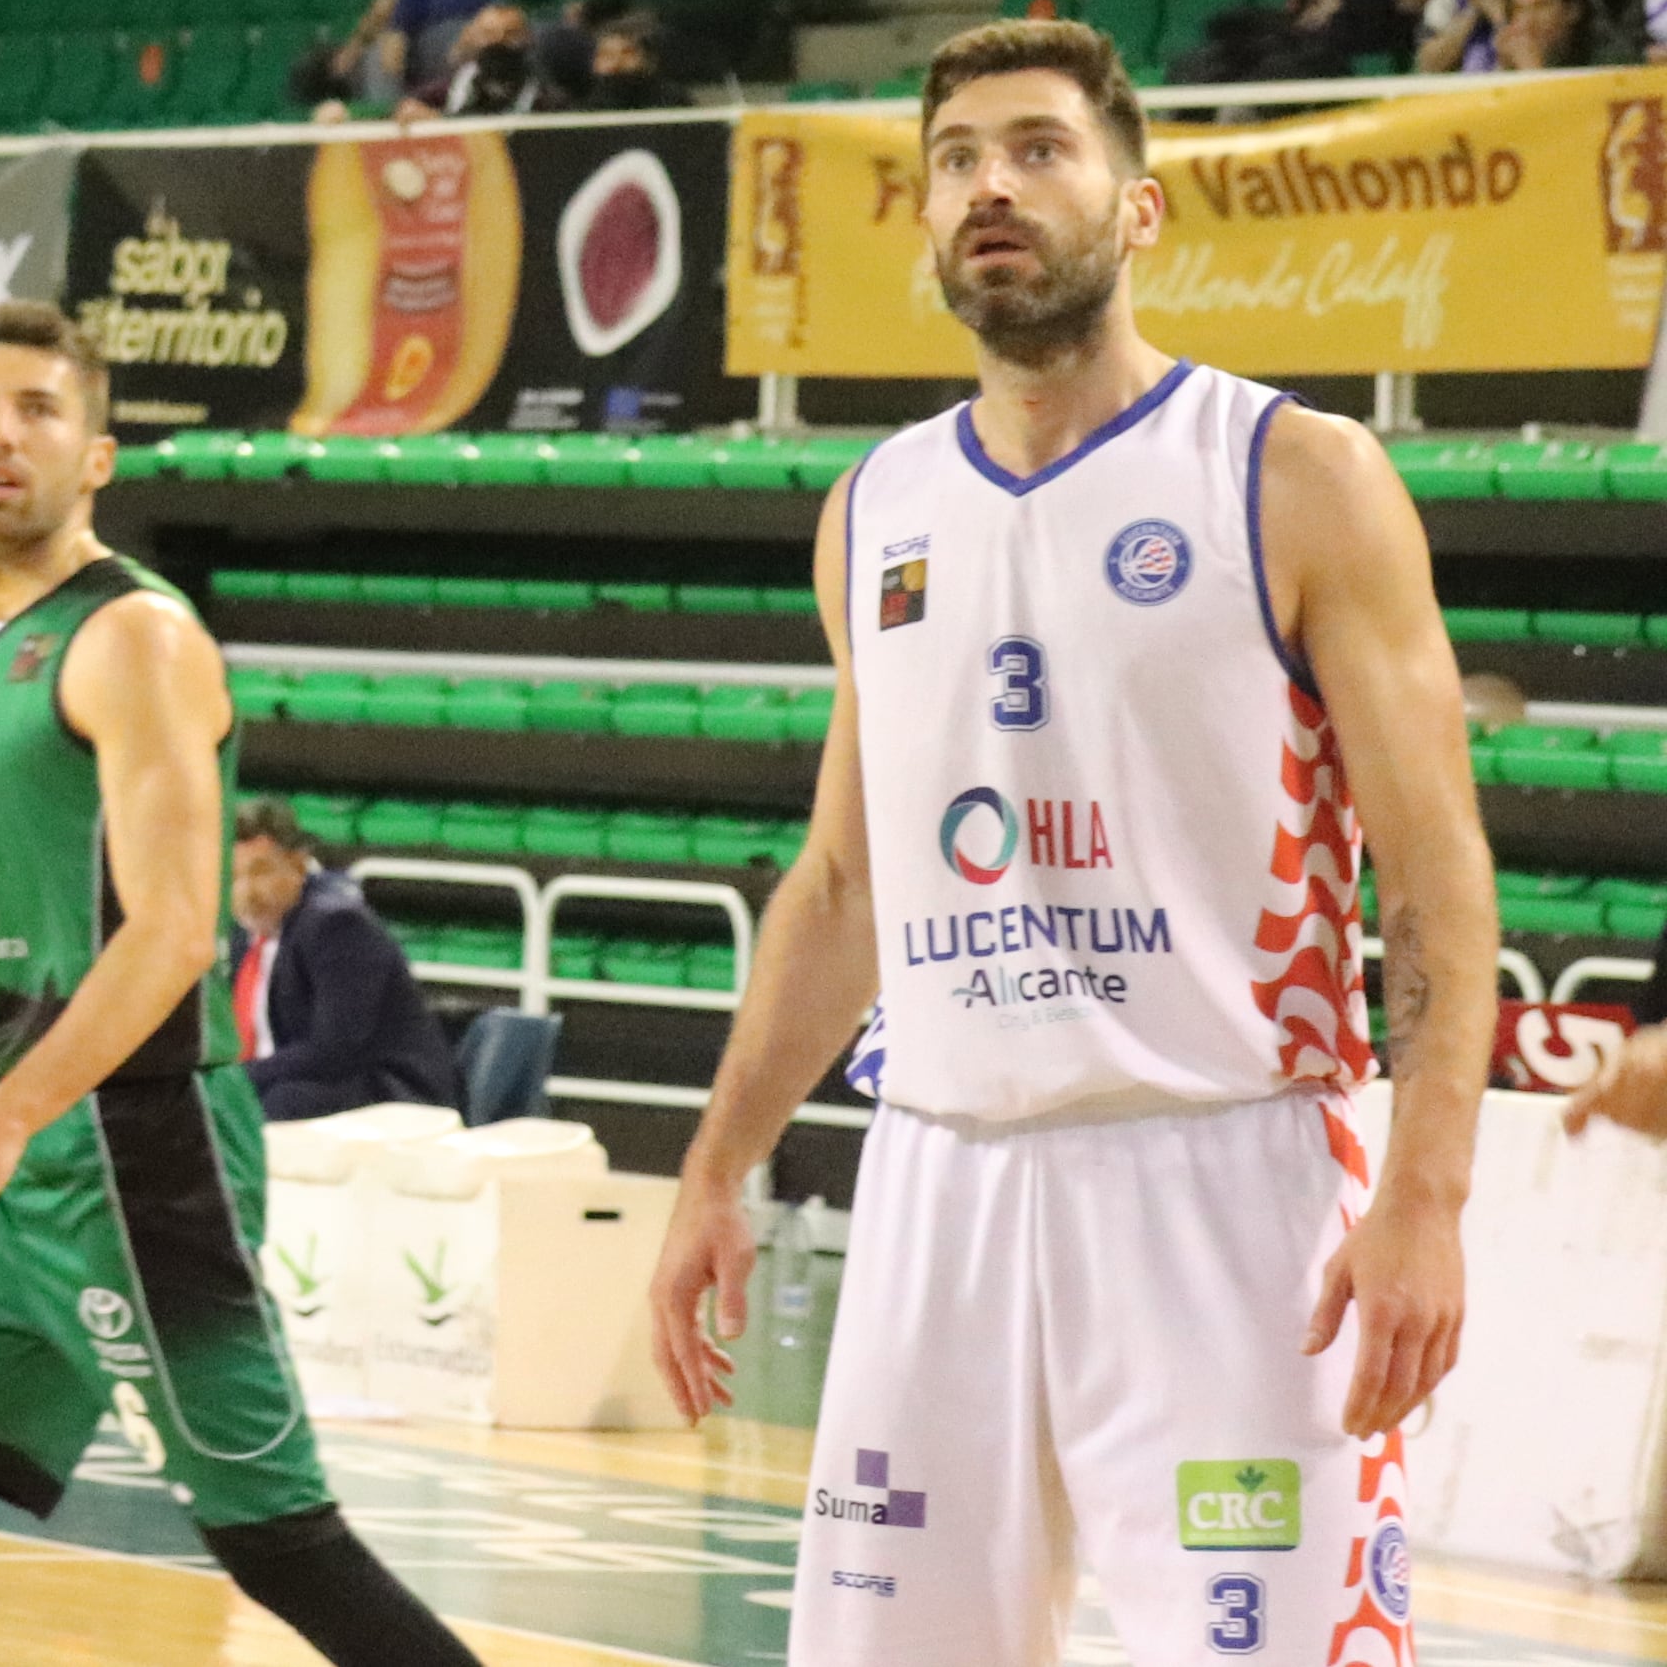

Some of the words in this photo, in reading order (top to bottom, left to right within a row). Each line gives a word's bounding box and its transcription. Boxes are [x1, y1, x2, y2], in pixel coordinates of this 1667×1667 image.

[1190, 131, 1526, 222] Valhondo
[112, 218, 232, 296] sabor
[988, 635, 1051, 732] 3
[1025, 797, 1114, 870] HLA
[904, 903, 1172, 966] LUCENTUM
[957, 964, 1128, 1008] Alicante
[815, 1488, 888, 1524] Suma
[1188, 1491, 1286, 1530] CRC
[1206, 1572, 1267, 1655] 3
